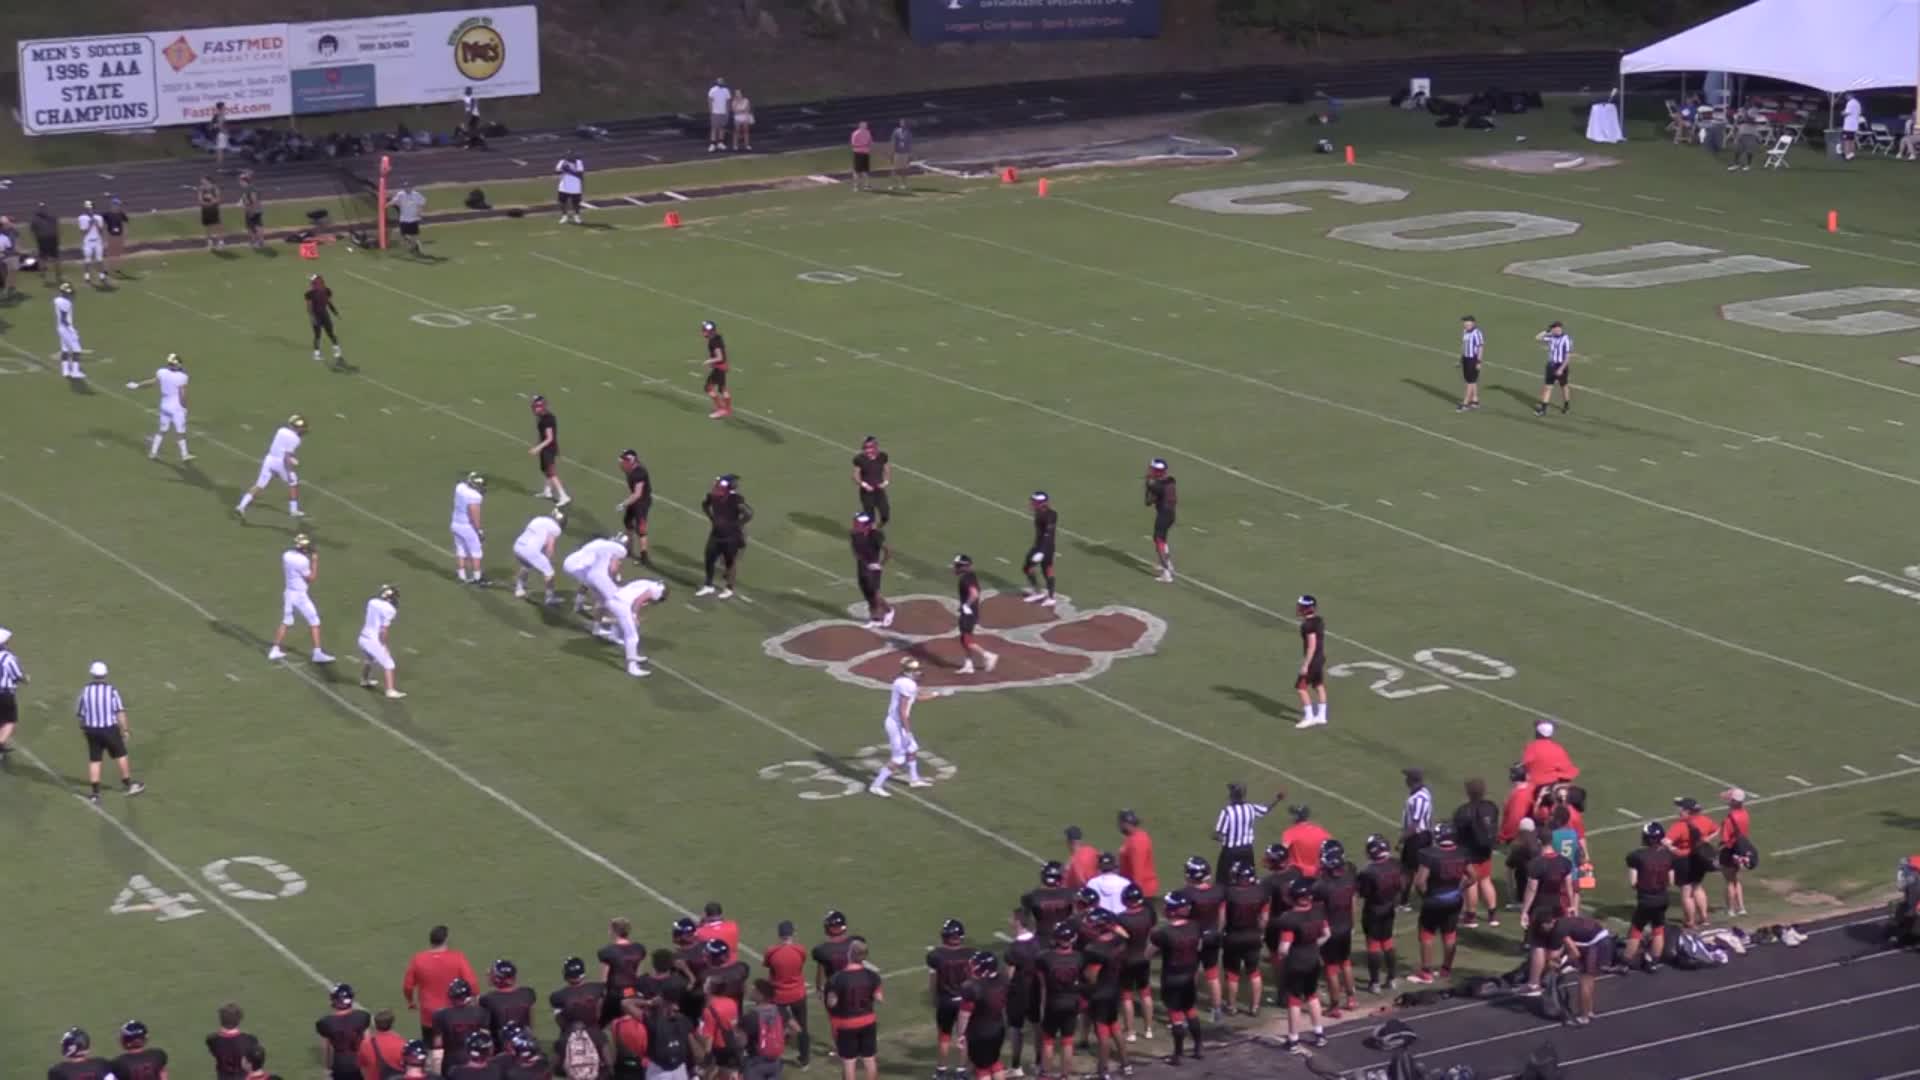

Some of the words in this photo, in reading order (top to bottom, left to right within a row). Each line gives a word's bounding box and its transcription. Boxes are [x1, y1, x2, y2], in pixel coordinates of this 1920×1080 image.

[31, 45, 81, 62] MEN'S
[87, 42, 143, 58] SOCCER
[202, 37, 283, 54] FASTMED
[46, 64, 90, 82] 1996
[99, 60, 142, 78] AAA
[61, 83, 124, 102] STATE
[35, 102, 149, 126] CHAMPIONS
[1327, 647, 1517, 699] 20
[1560, 839, 1573, 857] 5
[109, 855, 308, 921] 40
